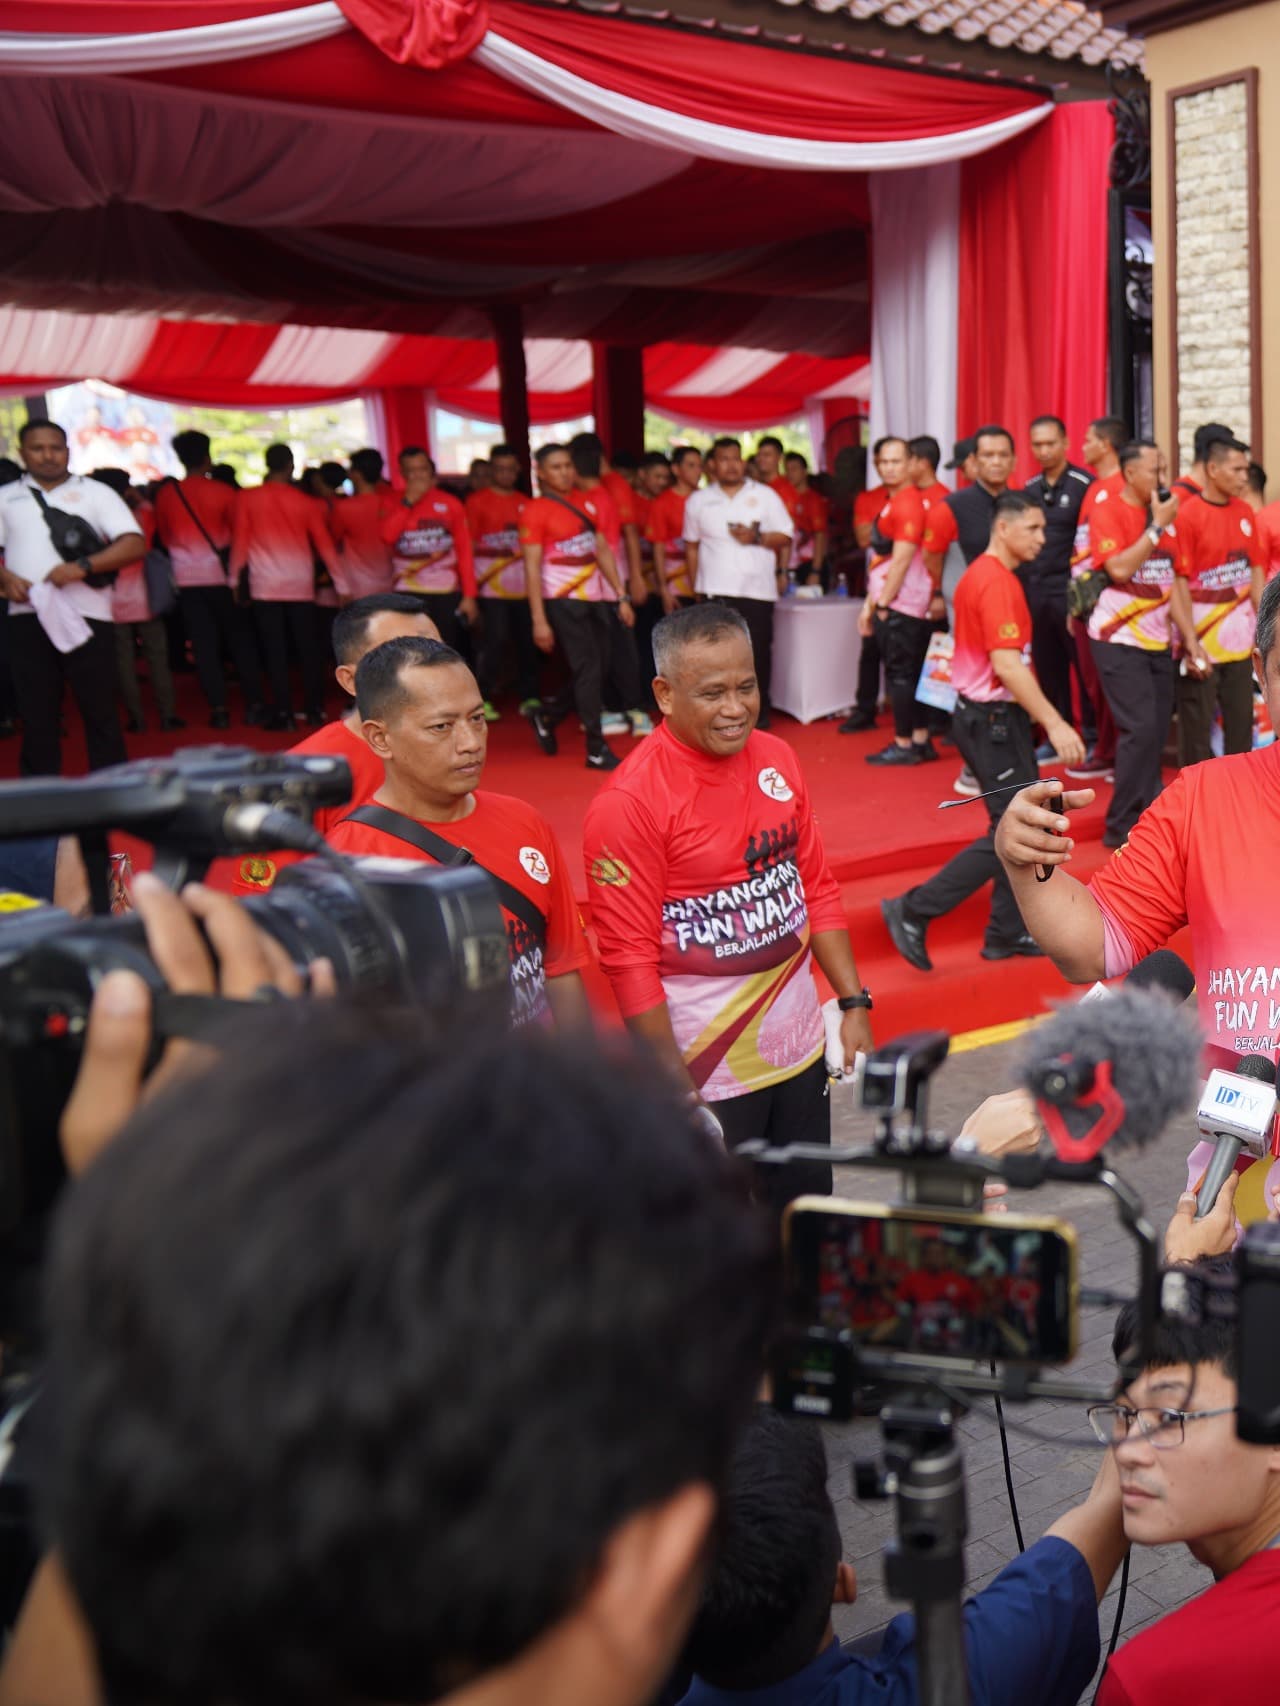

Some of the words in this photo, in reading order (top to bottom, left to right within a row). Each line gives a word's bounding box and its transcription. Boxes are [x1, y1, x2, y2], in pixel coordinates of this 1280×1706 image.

[675, 913, 735, 952] FUN
[741, 880, 802, 934] WALK
[715, 929, 777, 959] BERJALAN
[1214, 999, 1259, 1034] FUN
